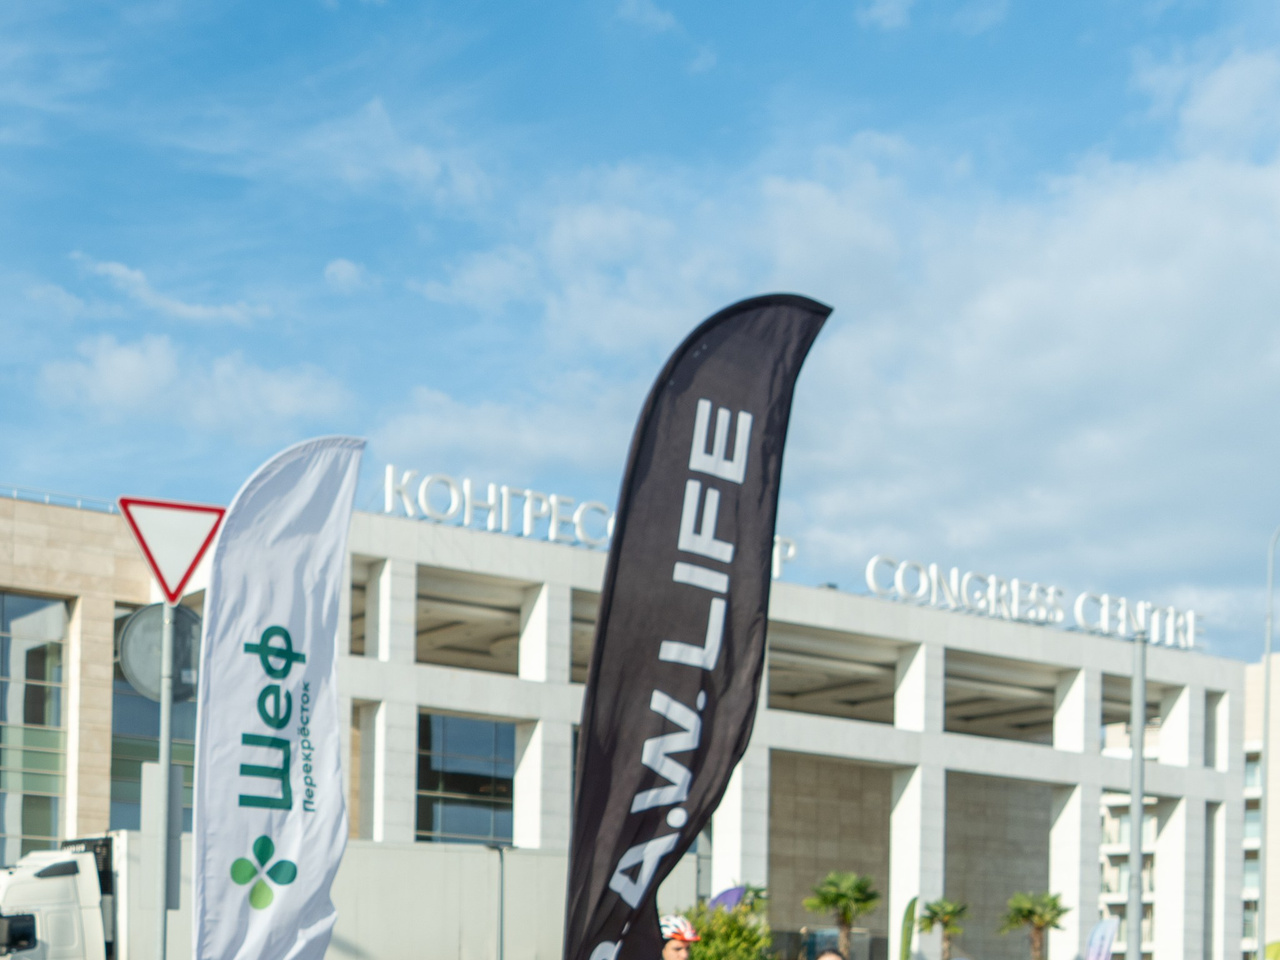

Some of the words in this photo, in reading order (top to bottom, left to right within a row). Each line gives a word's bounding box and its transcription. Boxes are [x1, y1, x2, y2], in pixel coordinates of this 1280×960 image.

[384, 463, 616, 547] КОНГРЕС
[865, 554, 1065, 624] CONGRESS
[238, 624, 306, 812] Шеф
